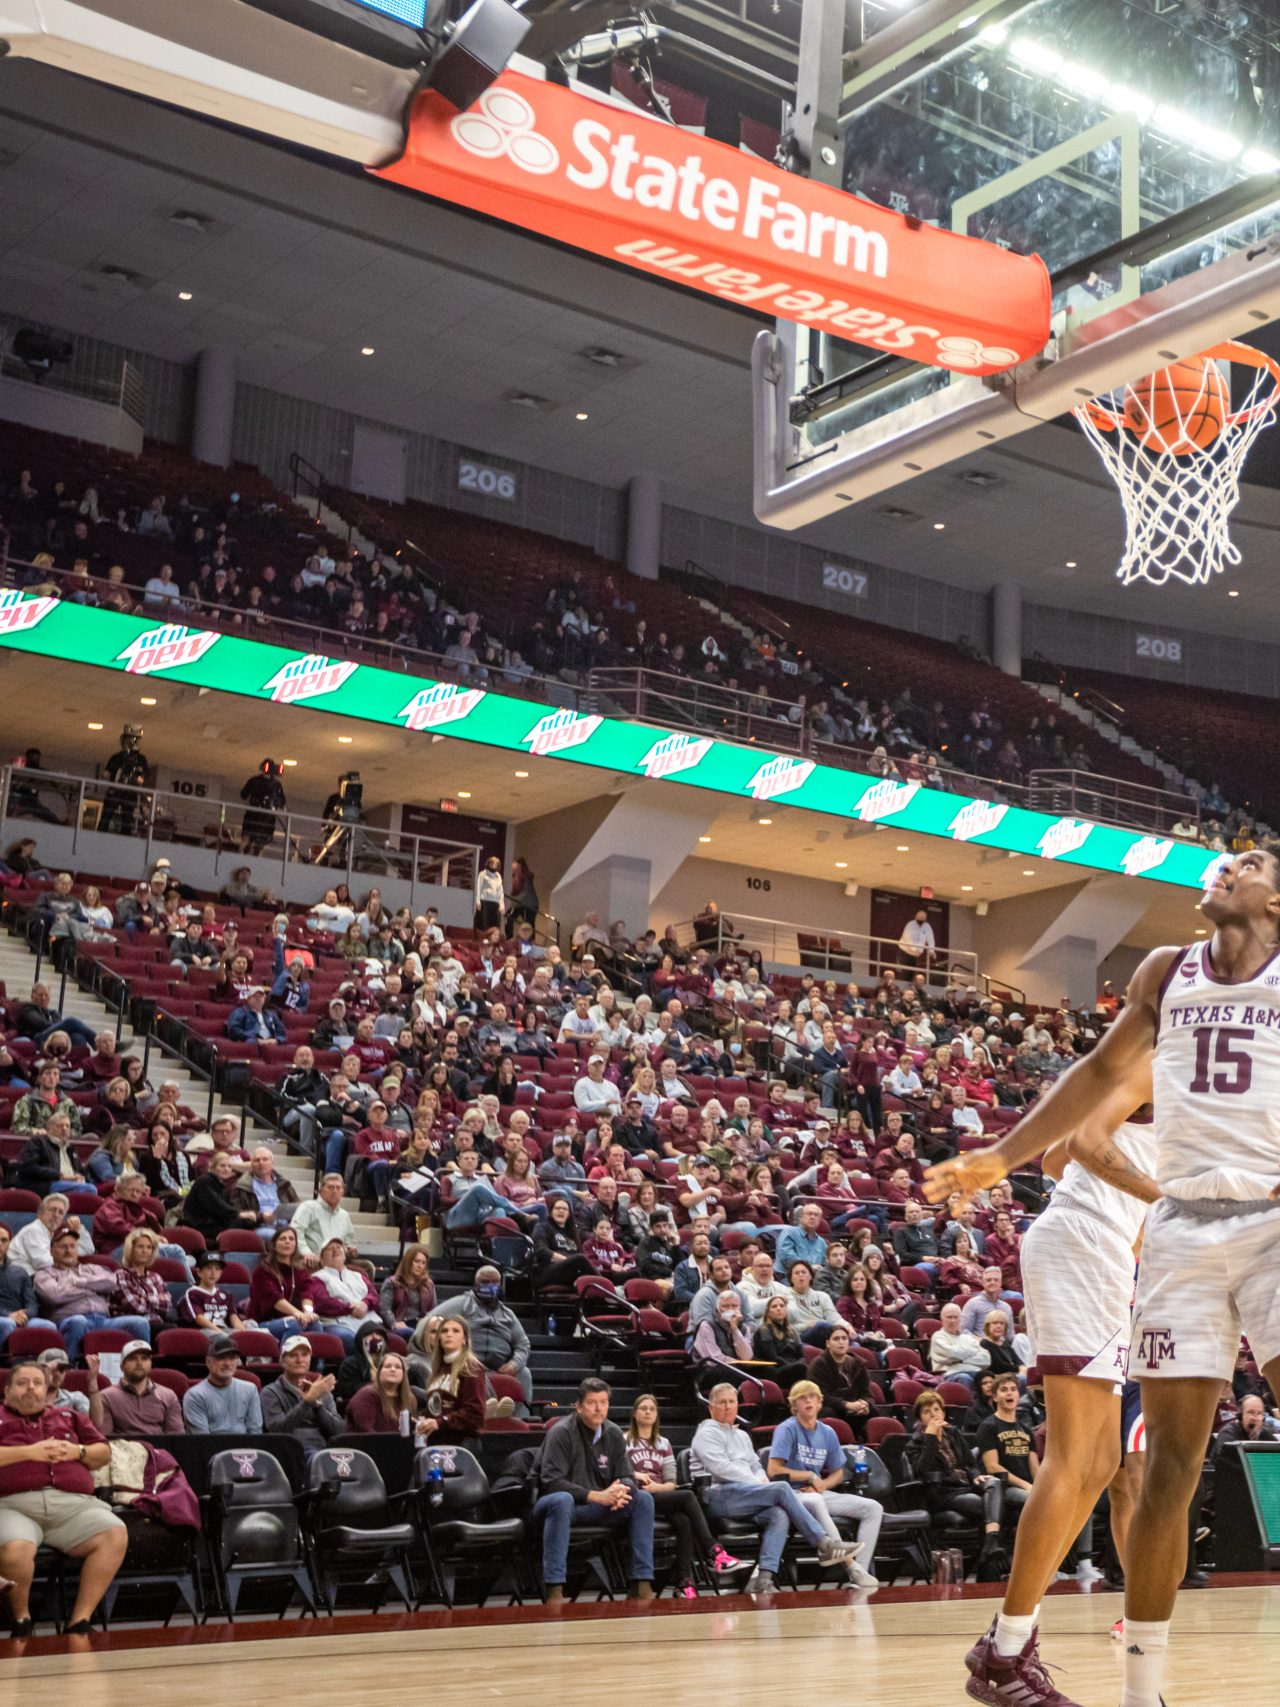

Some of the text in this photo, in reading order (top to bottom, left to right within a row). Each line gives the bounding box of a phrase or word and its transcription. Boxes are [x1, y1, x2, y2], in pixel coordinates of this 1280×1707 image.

[459, 464, 514, 498] 206
[823, 566, 867, 594] 207
[140, 626, 185, 648] mtn
[1136, 636, 1182, 660] 208
[172, 780, 207, 798] 105
[746, 876, 772, 892] 106
[1170, 1005, 1235, 1027] TEXAS
[1189, 1027, 1255, 1094] 15
